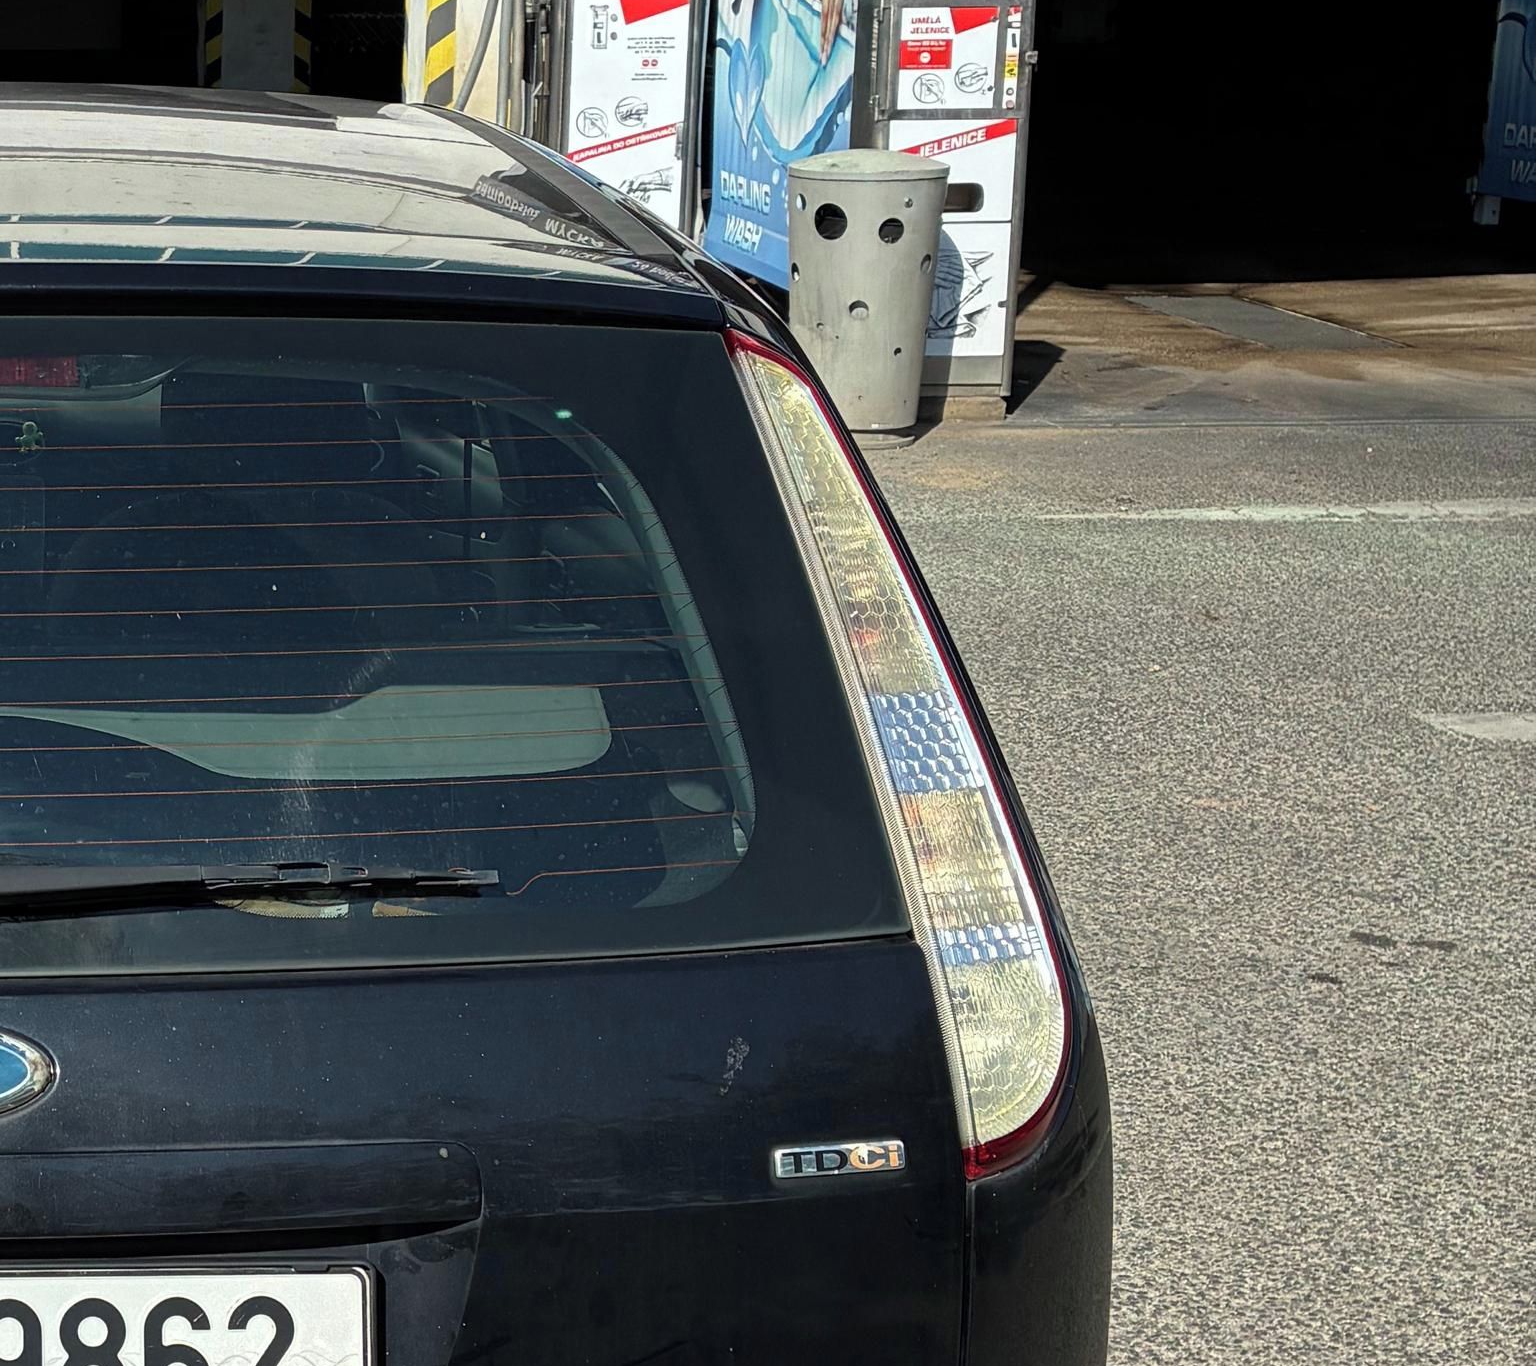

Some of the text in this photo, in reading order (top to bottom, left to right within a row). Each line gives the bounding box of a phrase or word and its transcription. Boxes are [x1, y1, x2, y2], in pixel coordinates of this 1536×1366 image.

[910, 26, 950, 34] JELENICE
[720, 169, 771, 216] DARLING
[722, 213, 763, 255] WASH
[781, 1143, 901, 1174] TDCi
